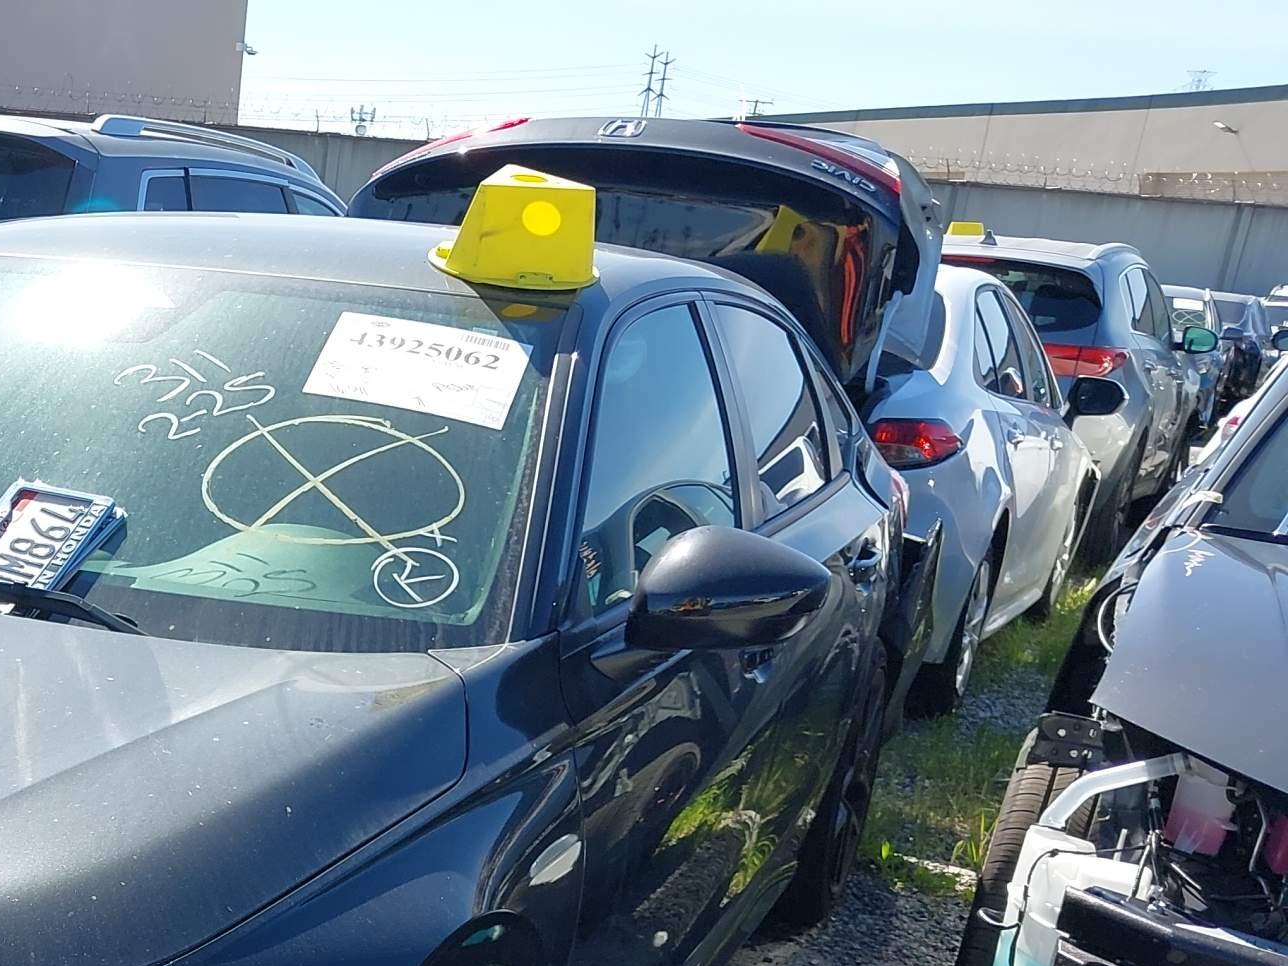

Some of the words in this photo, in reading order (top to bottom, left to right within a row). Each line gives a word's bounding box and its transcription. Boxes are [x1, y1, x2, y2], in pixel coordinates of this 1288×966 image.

[810, 159, 877, 192] CIVIC
[349, 331, 502, 370] 43925062
[52, 503, 108, 567] HONDA
